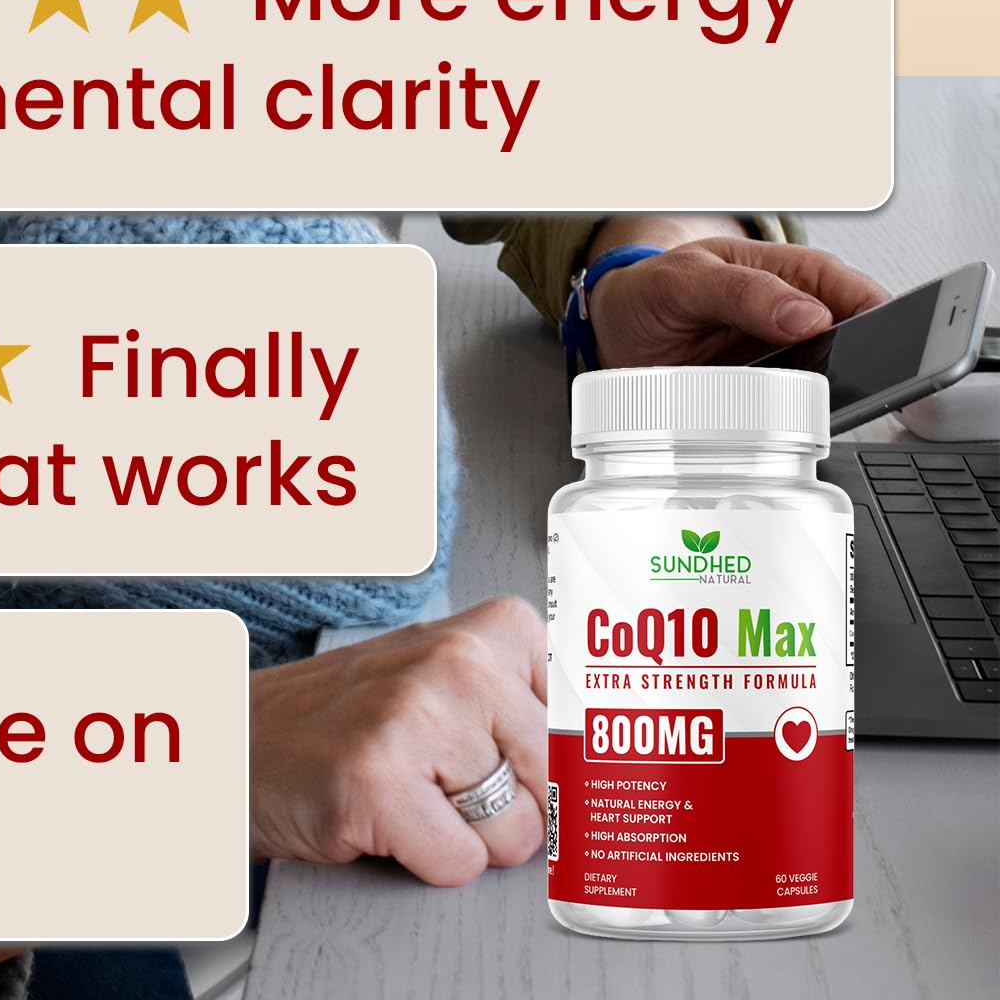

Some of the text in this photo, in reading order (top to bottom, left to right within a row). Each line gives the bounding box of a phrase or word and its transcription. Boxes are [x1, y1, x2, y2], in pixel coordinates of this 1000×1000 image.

[650, 555, 752, 574] SUNDHED
[698, 574, 752, 585] NATURAL
[586, 608, 816, 666] CoQ10 Max
[585, 673, 817, 690] EXTRA STRENGTH FORMULA
[591, 714, 714, 756] 800MG
[591, 780, 667, 791] HIGH POTENCY
[591, 798, 693, 810] NATURAL ENERGY &
[590, 812, 673, 824] HEART SUPPORT
[591, 831, 687, 843] HIGH ABSORPTION
[591, 850, 740, 862] NO ARTIFICIAL INGREDIENTS
[584, 873, 617, 883] DIETARY
[775, 872, 818, 884] 60 VEGGIE
[584, 885, 637, 897] SUPPLEMENT
[776, 885, 819, 896] CAPSULES
